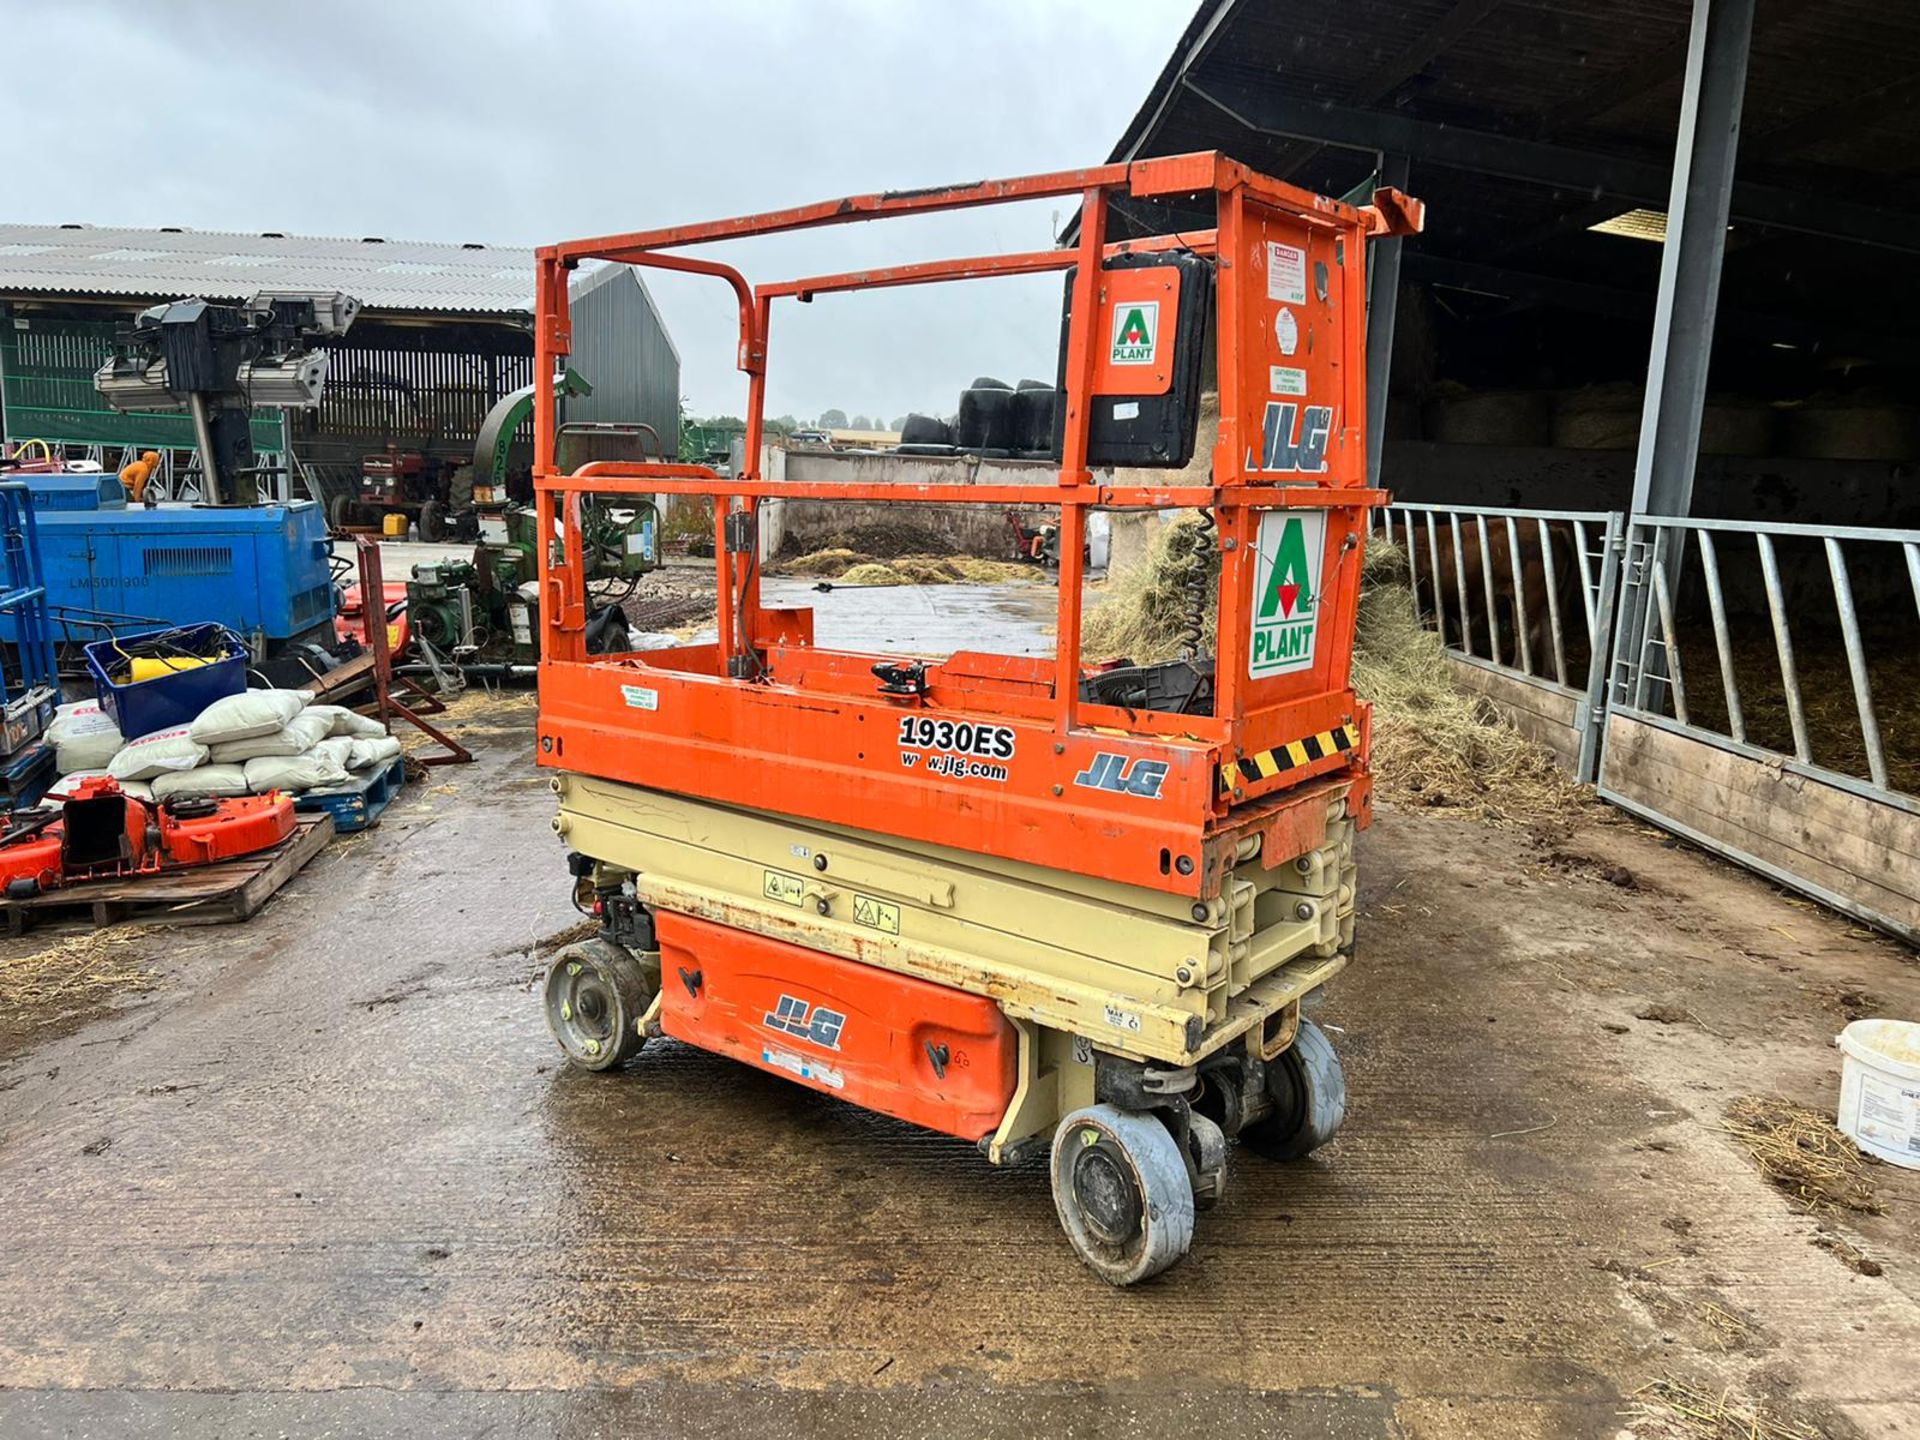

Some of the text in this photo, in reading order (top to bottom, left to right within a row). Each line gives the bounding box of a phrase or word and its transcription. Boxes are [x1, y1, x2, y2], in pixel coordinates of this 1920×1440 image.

[1117, 309, 1150, 345] A
[1113, 348, 1152, 360] PLANT
[1245, 401, 1333, 473] JLG
[1259, 518, 1313, 617] A
[1253, 625, 1313, 663] PLANT
[900, 716, 1014, 758] 1930ES
[1074, 752, 1168, 798] JLG
[763, 994, 846, 1049] JLG
